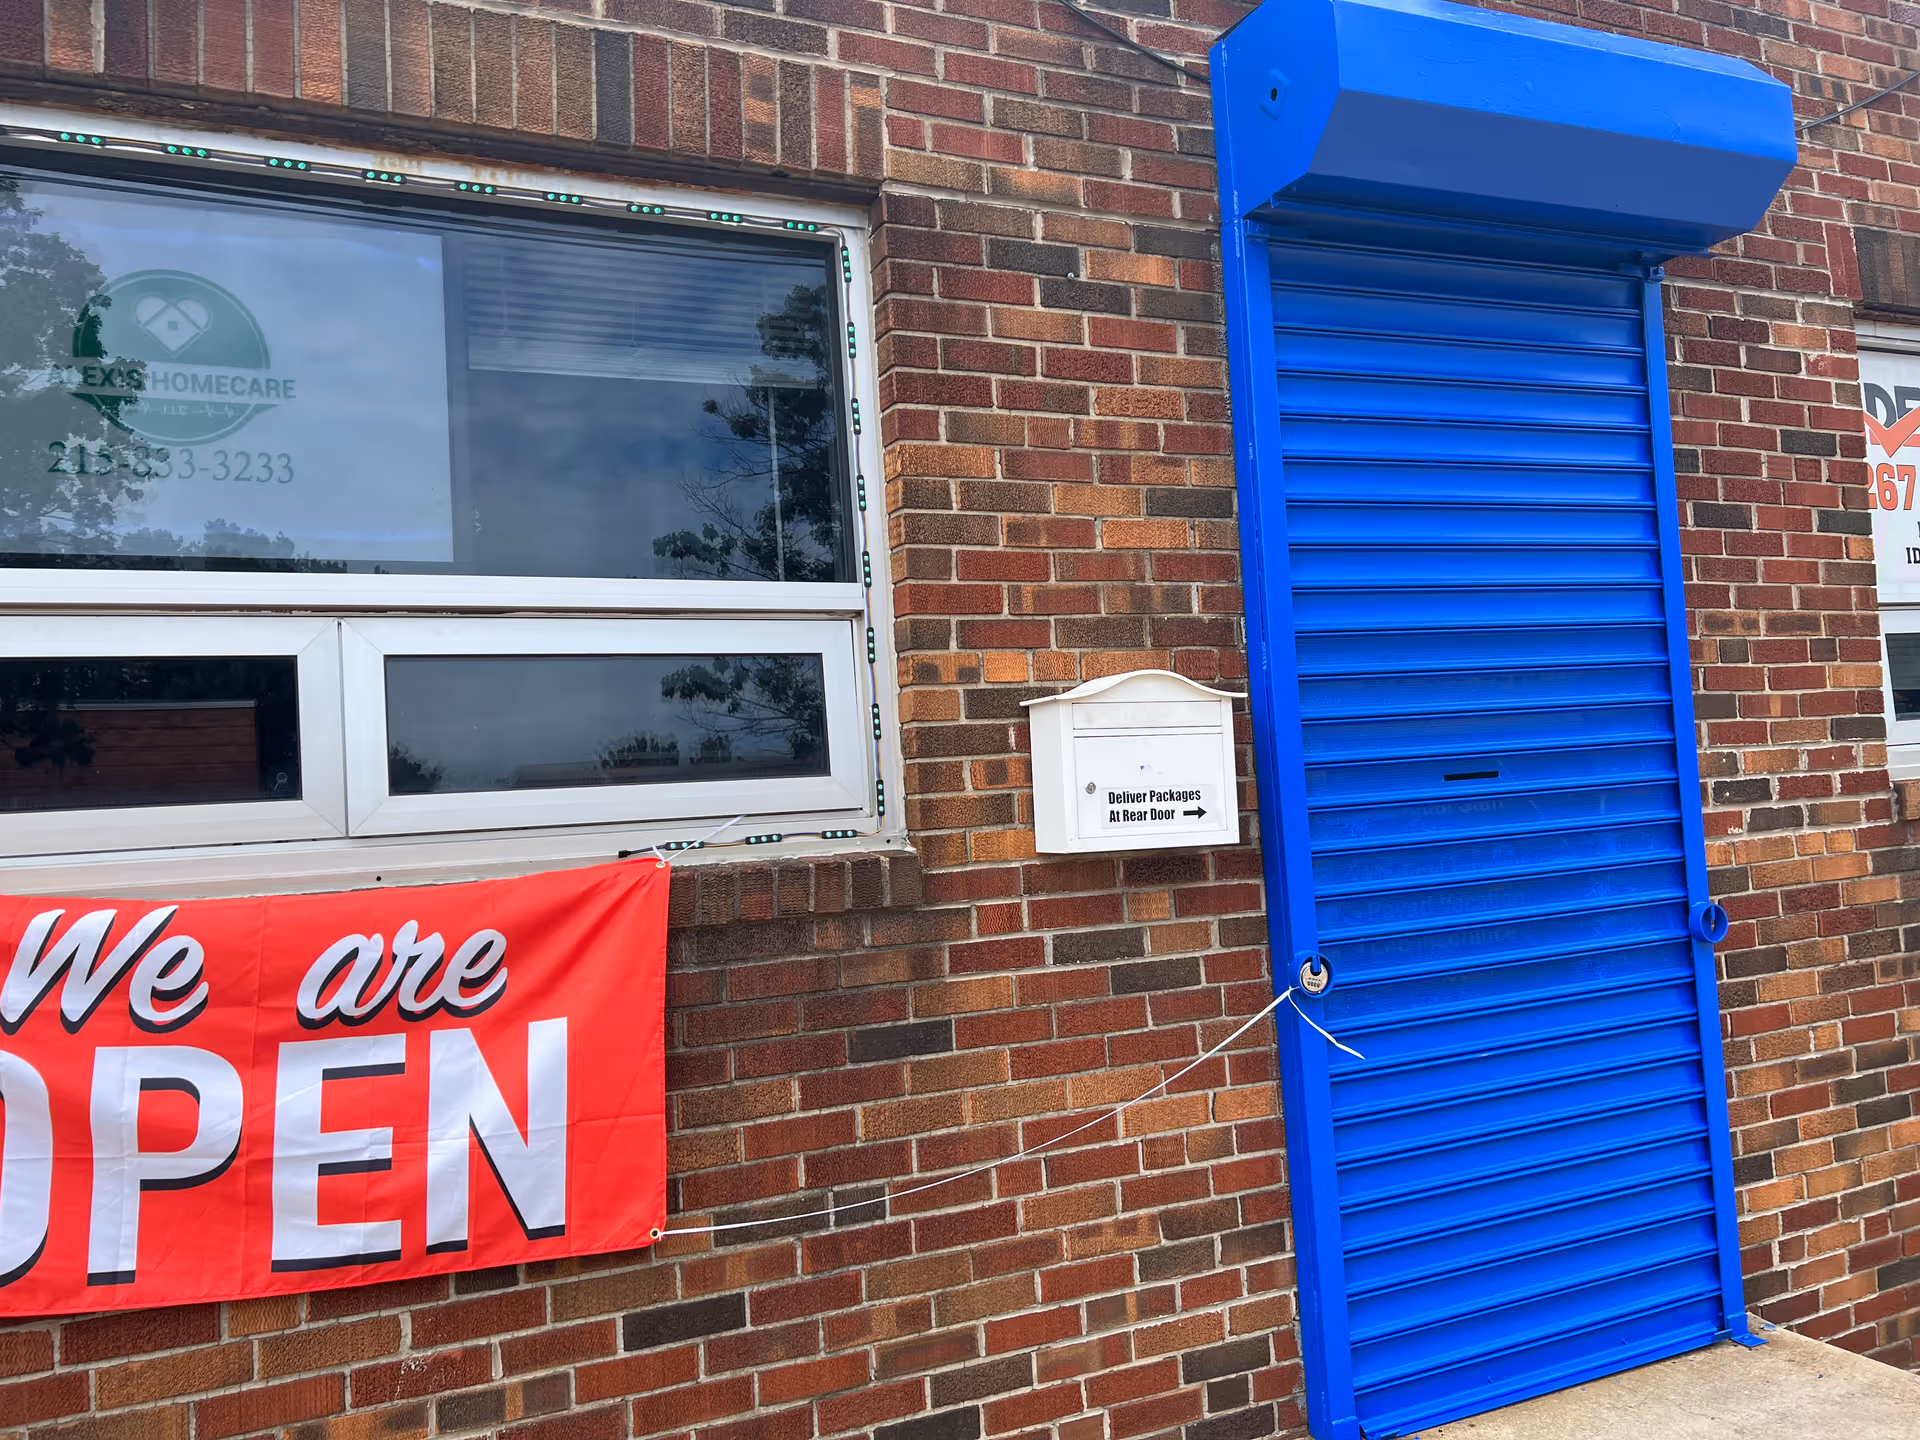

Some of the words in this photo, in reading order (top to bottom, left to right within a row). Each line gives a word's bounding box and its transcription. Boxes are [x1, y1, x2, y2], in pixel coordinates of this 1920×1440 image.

[151, 371, 297, 399] HOMECARE
[1108, 791, 1147, 804] Deliver
[1150, 789, 1201, 802] Packages
[1109, 810, 1121, 823] At
[1123, 809, 1148, 822] Rear
[1150, 808, 1175, 820] Door
[1, 904, 209, 1035] We
[296, 919, 508, 1031] are
